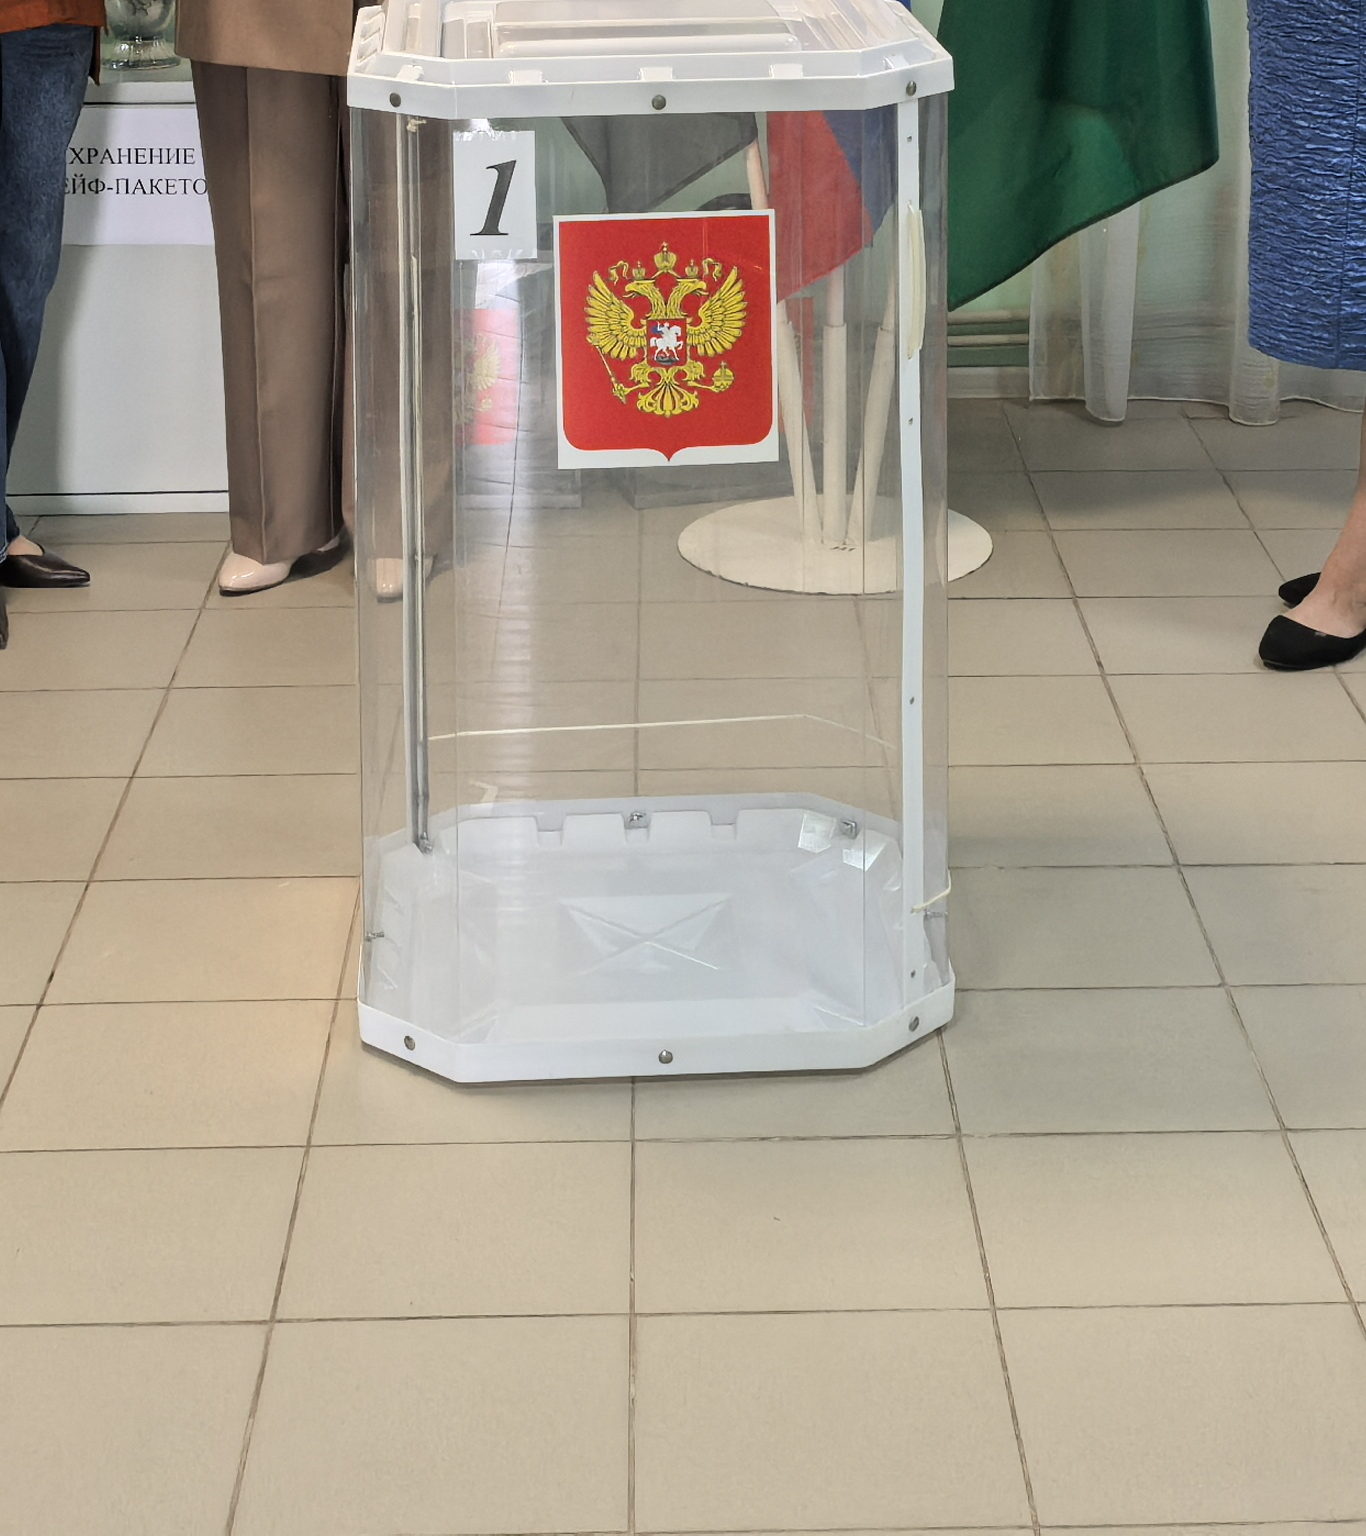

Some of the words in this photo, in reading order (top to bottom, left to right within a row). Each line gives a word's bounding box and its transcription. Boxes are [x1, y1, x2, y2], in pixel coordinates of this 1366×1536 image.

[69, 147, 196, 165] ХРАНЕНИЕ
[64, 173, 208, 195] ЕЙФ-ПАКЕТО
[470, 159, 517, 236] 1
